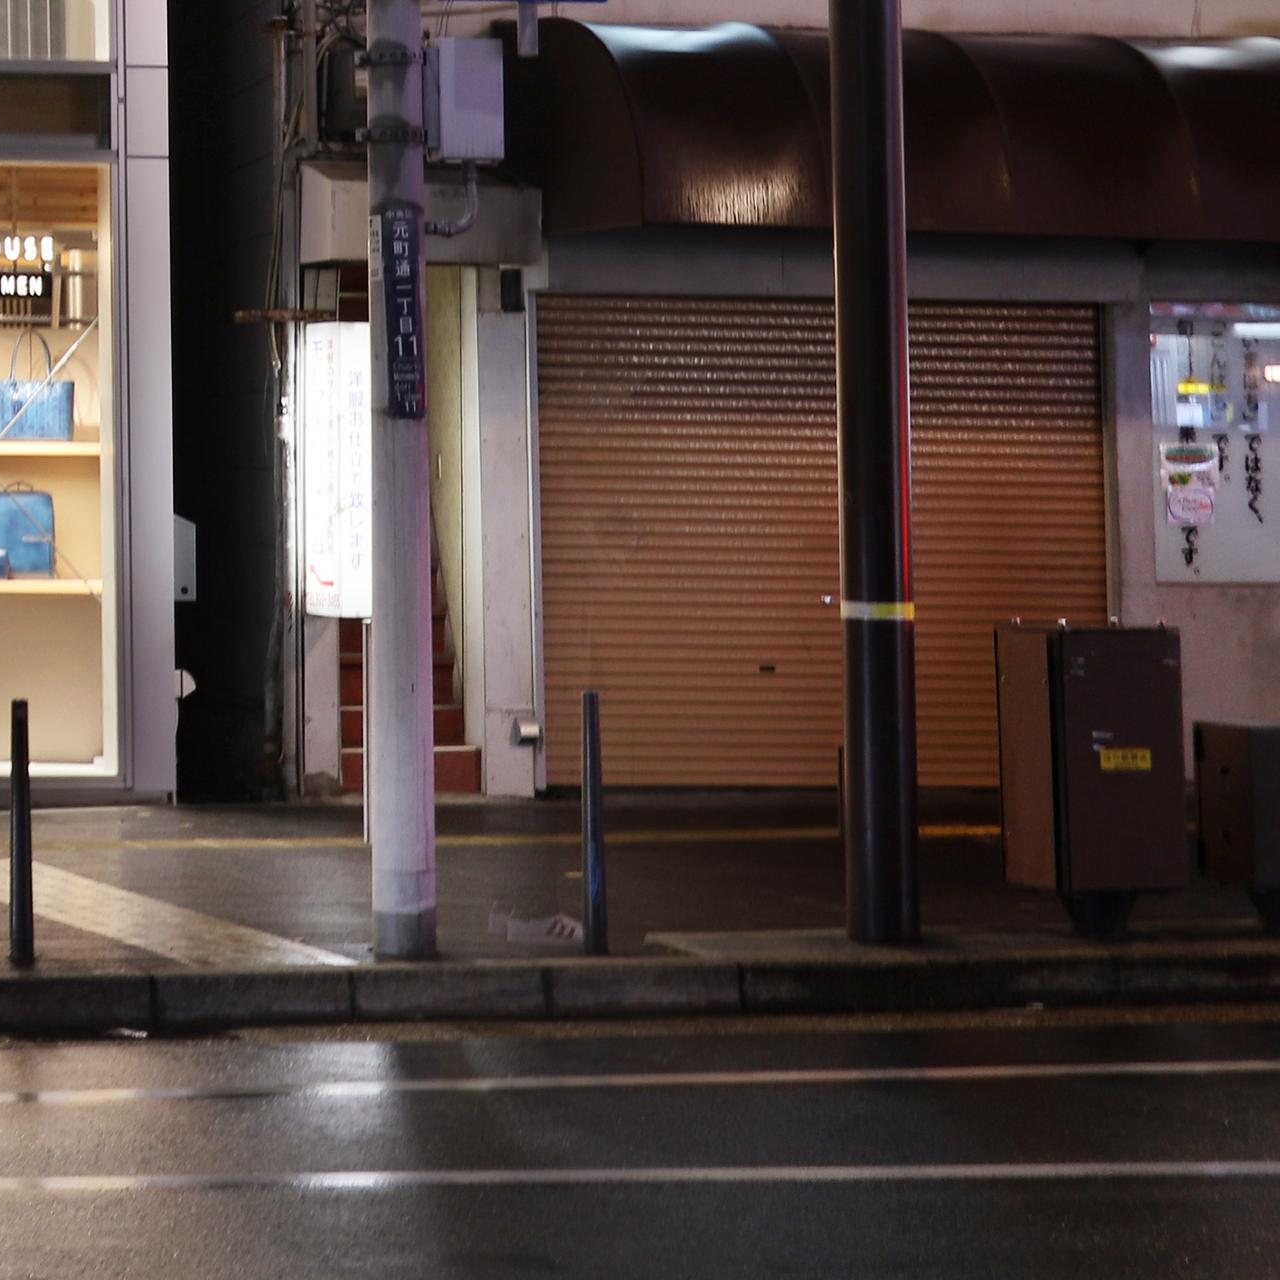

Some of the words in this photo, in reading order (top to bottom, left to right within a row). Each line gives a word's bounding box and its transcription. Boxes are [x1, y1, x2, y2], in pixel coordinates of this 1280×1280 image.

[0, 275, 43, 297] MEN
[393, 222, 413, 334] 元町通一丁目
[394, 335, 418, 357] 11
